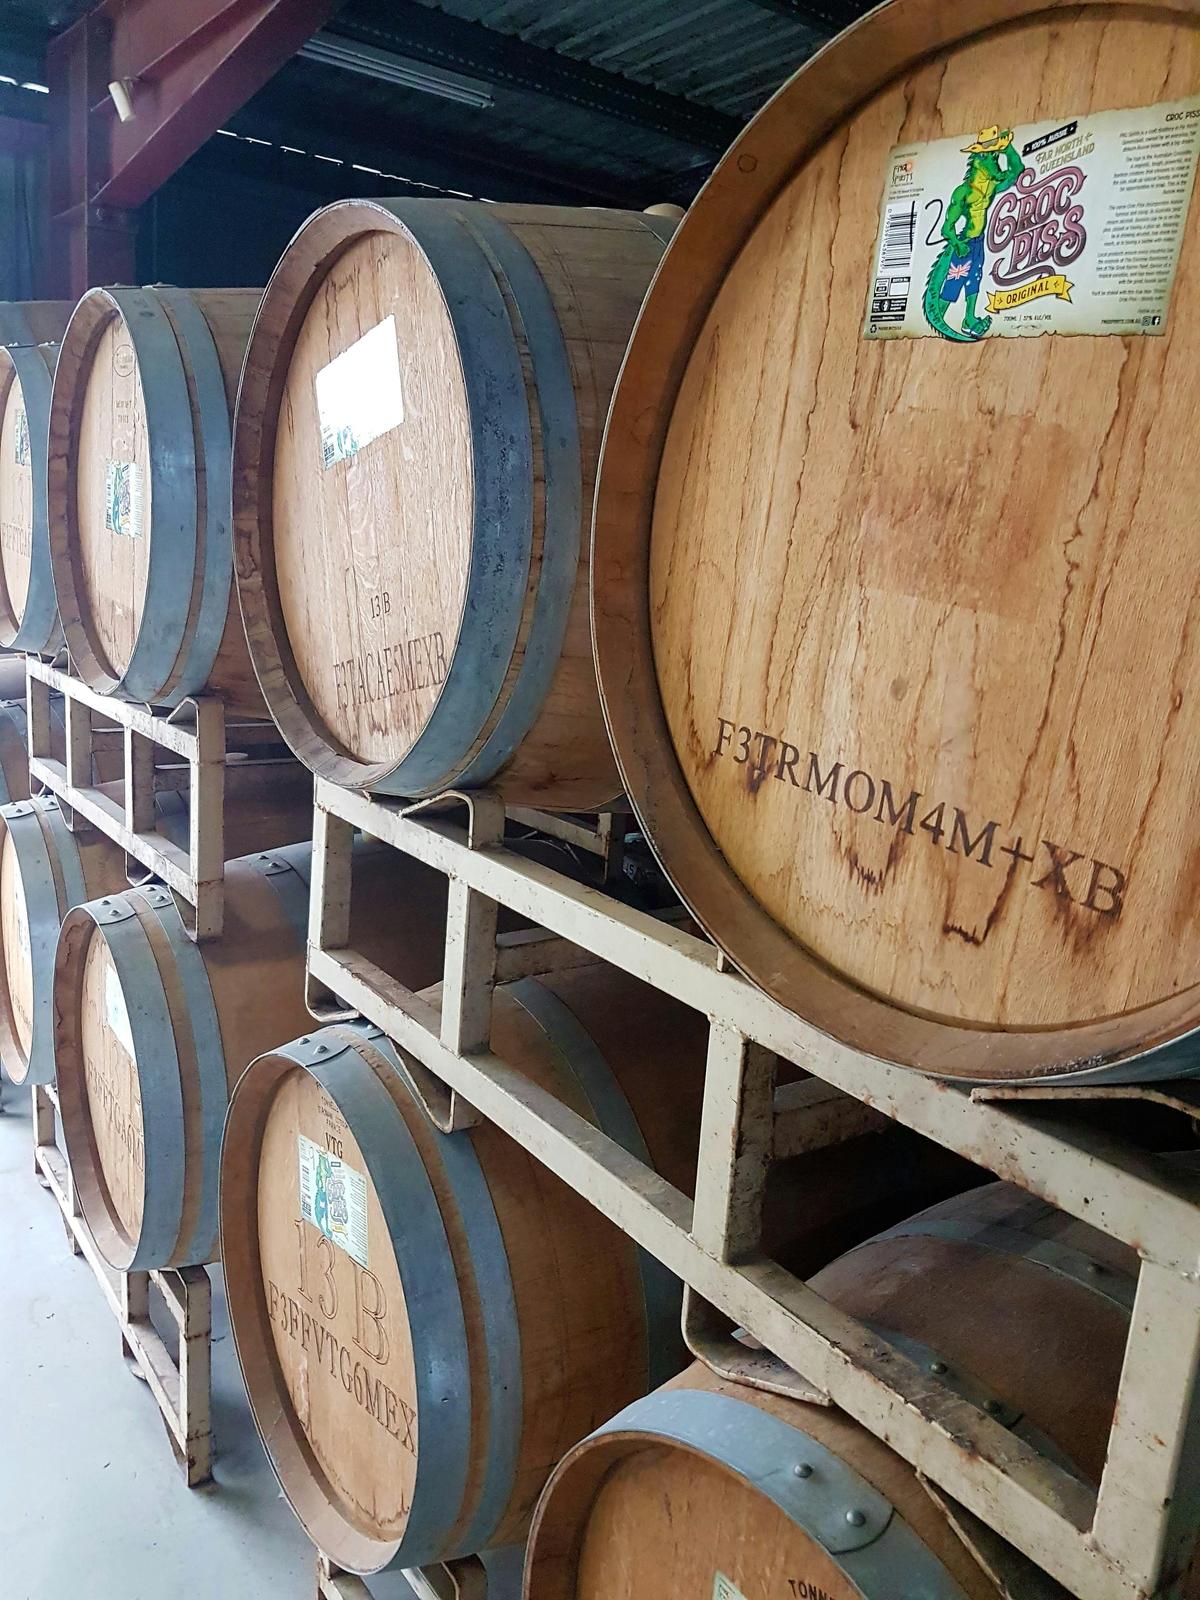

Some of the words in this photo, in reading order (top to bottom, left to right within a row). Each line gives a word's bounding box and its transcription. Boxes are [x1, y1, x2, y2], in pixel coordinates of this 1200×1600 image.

[1035, 149, 1053, 164] FAR
[1054, 135, 1084, 157] NORTH
[1047, 127, 1069, 143] AUSSIE
[1040, 142, 1095, 175] QUEENSLAND
[987, 174, 1082, 254] CROC
[1003, 205, 1087, 277] PISS
[1006, 281, 1049, 305] ORIGINAL
